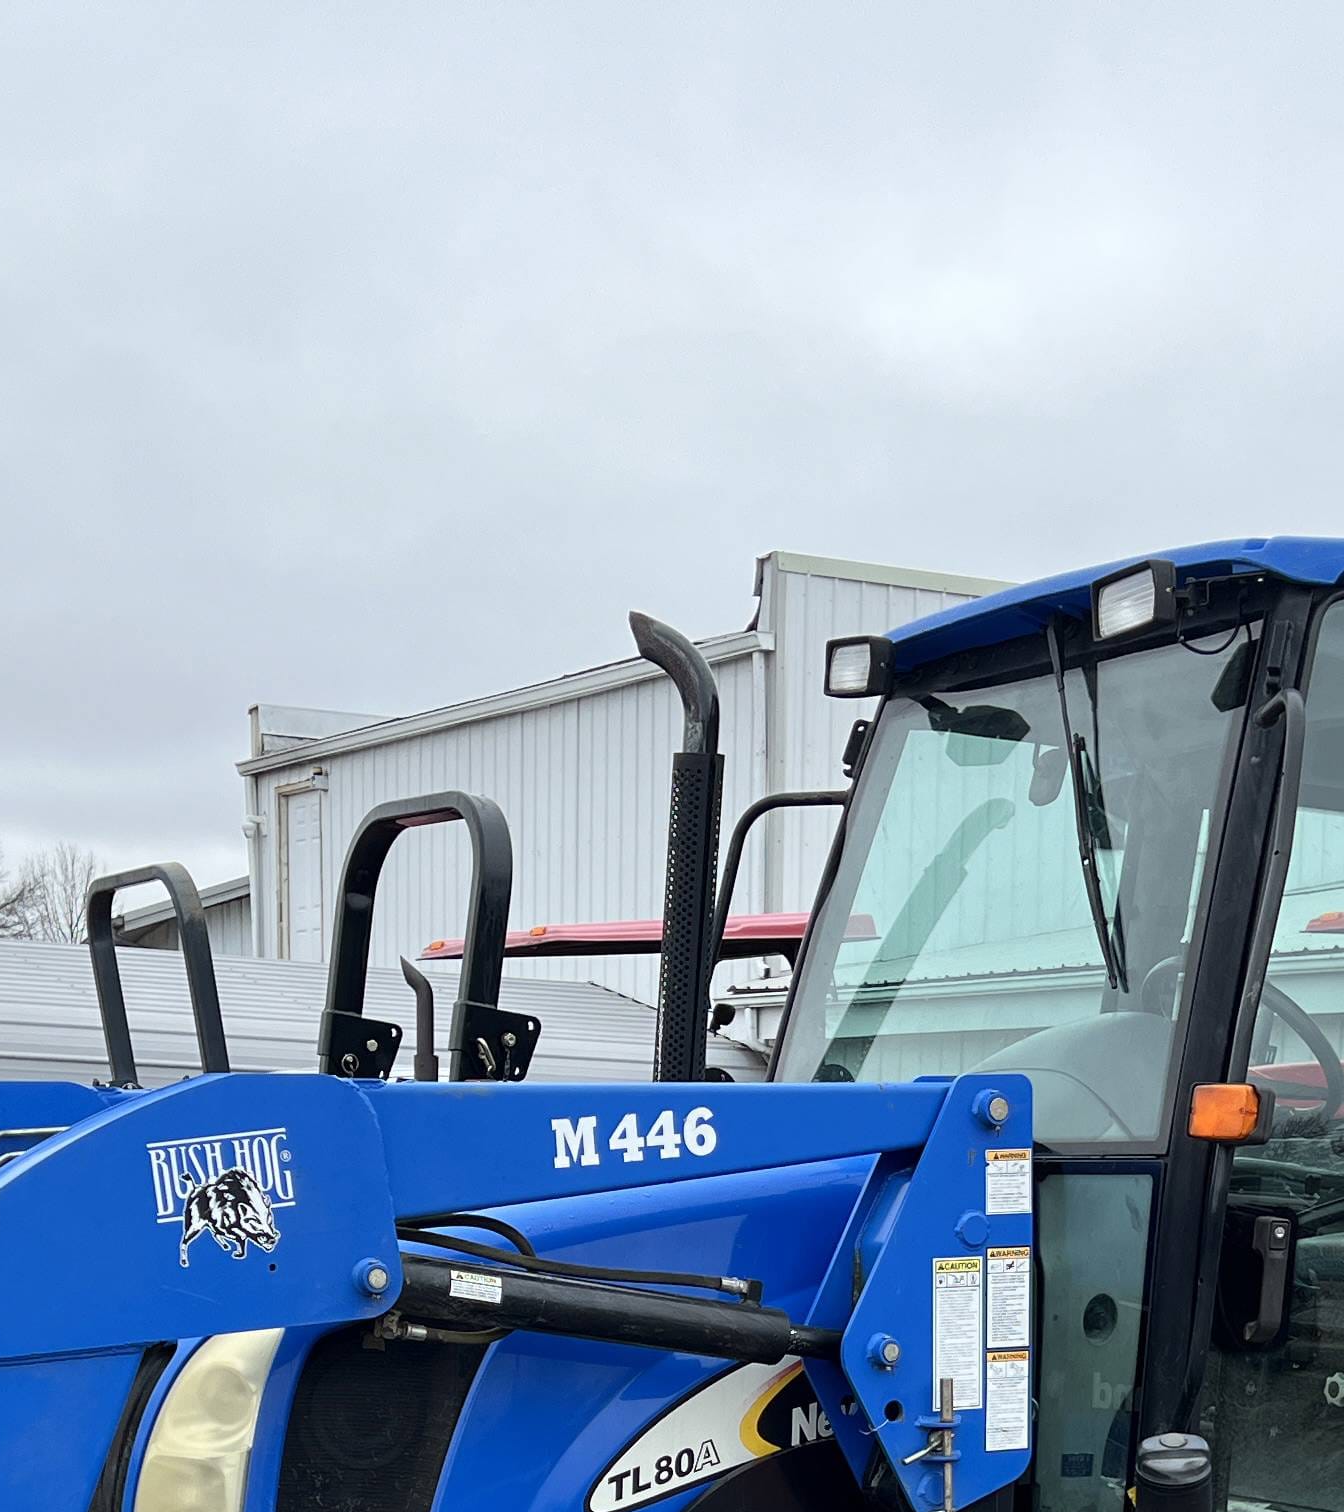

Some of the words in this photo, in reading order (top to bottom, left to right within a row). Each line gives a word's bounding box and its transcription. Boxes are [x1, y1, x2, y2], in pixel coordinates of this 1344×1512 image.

[551, 1115, 600, 1168] M
[609, 1106, 717, 1163] 446
[147, 1142, 224, 1217] BUSH
[944, 1261, 978, 1270] CAUTION
[996, 1249, 1029, 1257] WARNING
[607, 1438, 721, 1502] TL80A
